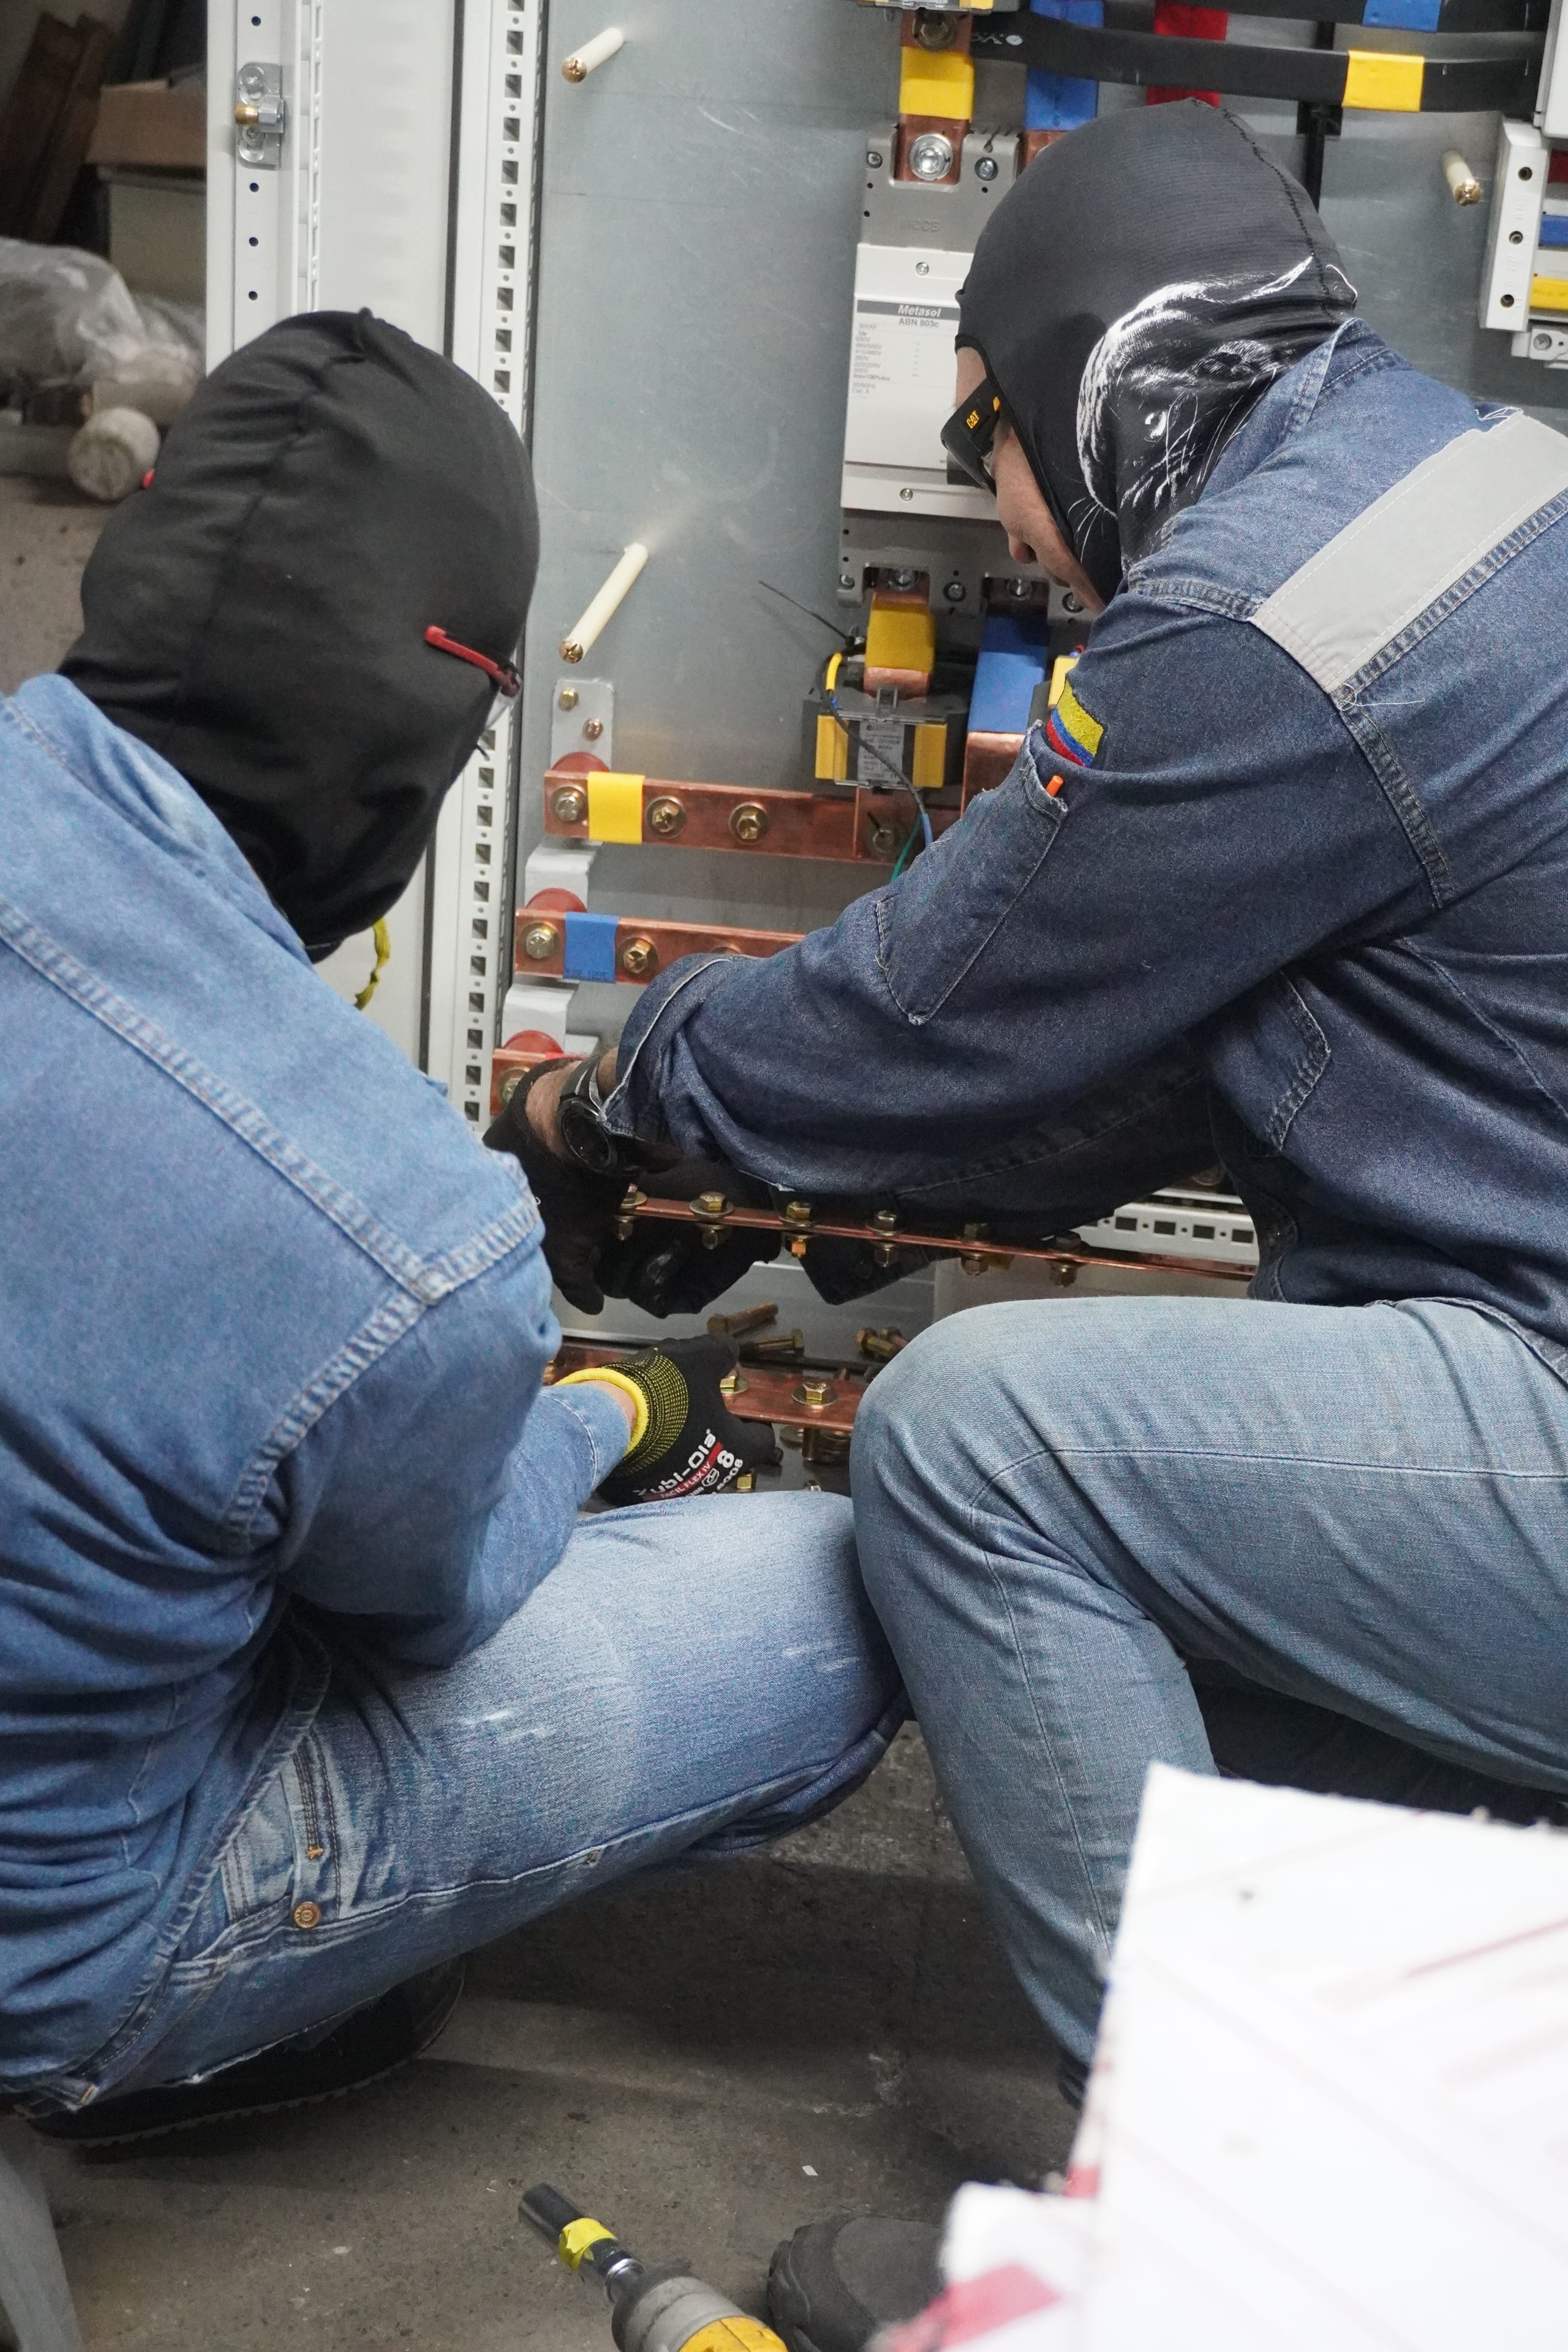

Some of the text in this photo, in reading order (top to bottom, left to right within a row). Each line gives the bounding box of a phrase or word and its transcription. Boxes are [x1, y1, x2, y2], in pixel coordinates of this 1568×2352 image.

[897, 304, 942, 317] Metasol
[920, 319, 940, 328] 803c
[966, 410, 980, 429] CAT
[717, 1450, 735, 1468] 8
[684, 1471, 704, 1488] FLEX
[701, 1461, 711, 1472] IV
